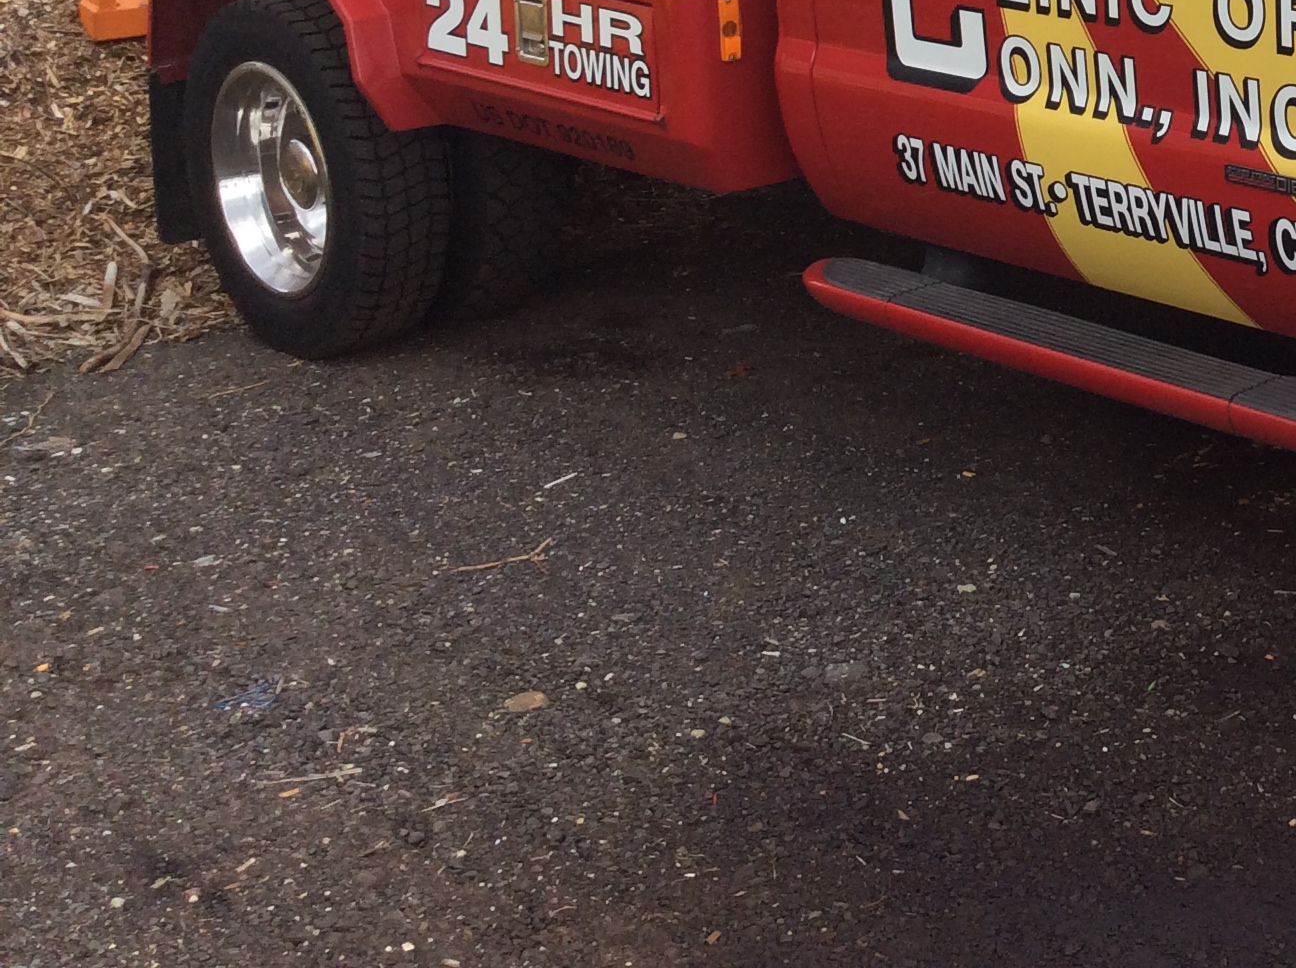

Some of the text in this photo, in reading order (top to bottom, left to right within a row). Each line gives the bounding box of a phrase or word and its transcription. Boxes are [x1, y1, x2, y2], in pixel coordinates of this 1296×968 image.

[549, 40, 651, 98] TOWING
[896, 134, 929, 184] 37
[932, 142, 1005, 204] MAIN
[1071, 172, 1268, 274] TERRYVILLE,
